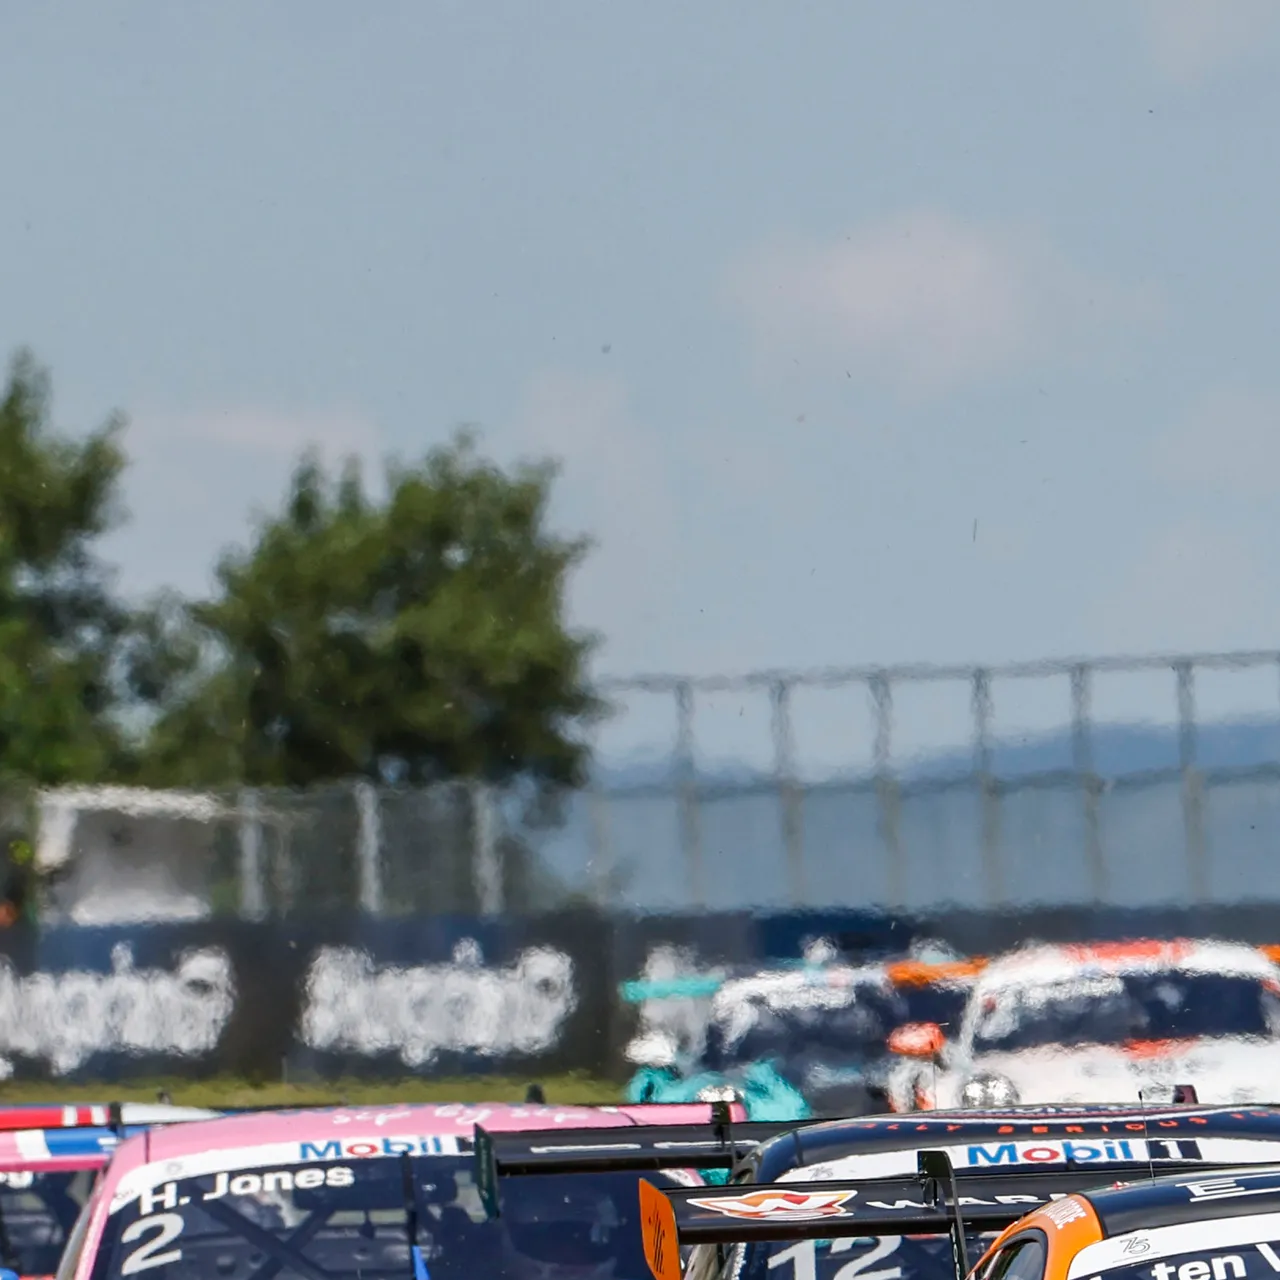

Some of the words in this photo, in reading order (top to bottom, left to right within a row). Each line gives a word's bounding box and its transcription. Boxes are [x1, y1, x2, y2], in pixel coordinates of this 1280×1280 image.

[300, 1136, 442, 1160] Mobil
[967, 1141, 1133, 1166] Mobil
[139, 1183, 191, 1215] H.
[203, 1167, 355, 1200] Jones
[121, 1213, 184, 1277] 2
